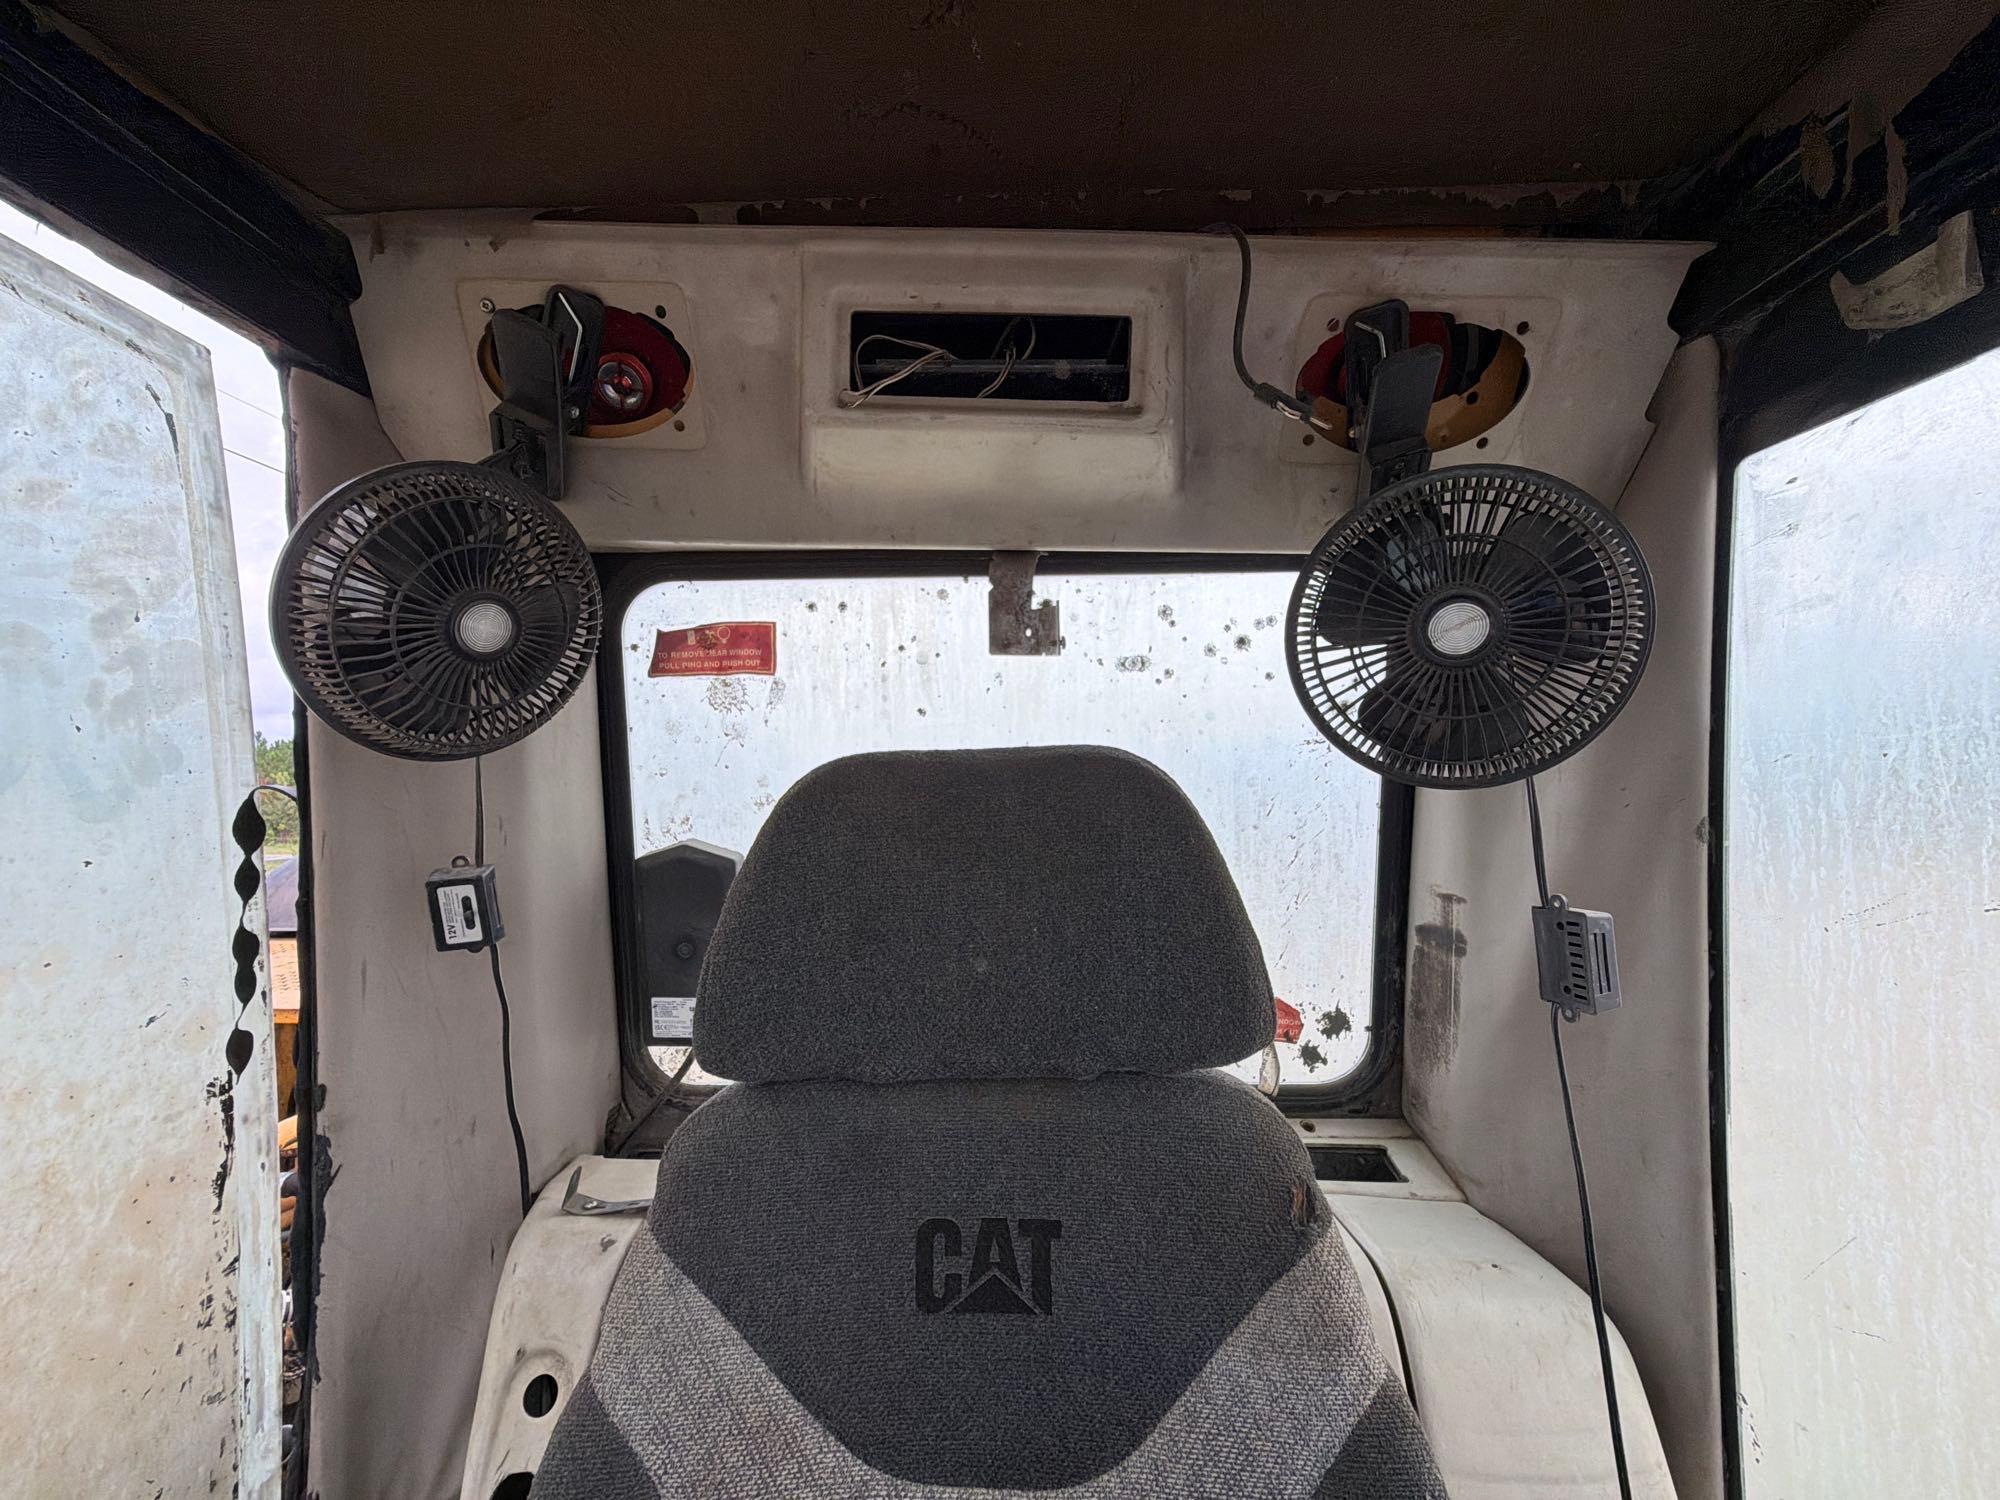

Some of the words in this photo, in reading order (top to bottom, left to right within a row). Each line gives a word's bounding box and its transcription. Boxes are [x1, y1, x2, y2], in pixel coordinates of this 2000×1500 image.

[670, 649, 704, 658] REMOVE
[729, 648, 761, 656] WINDOW
[659, 661, 681, 670] PULL
[704, 660, 720, 668] AND
[722, 660, 744, 668] PUSH
[745, 659, 760, 667] OUT
[447, 924, 457, 939] 12V
[914, 1216, 1063, 1316] CAT
